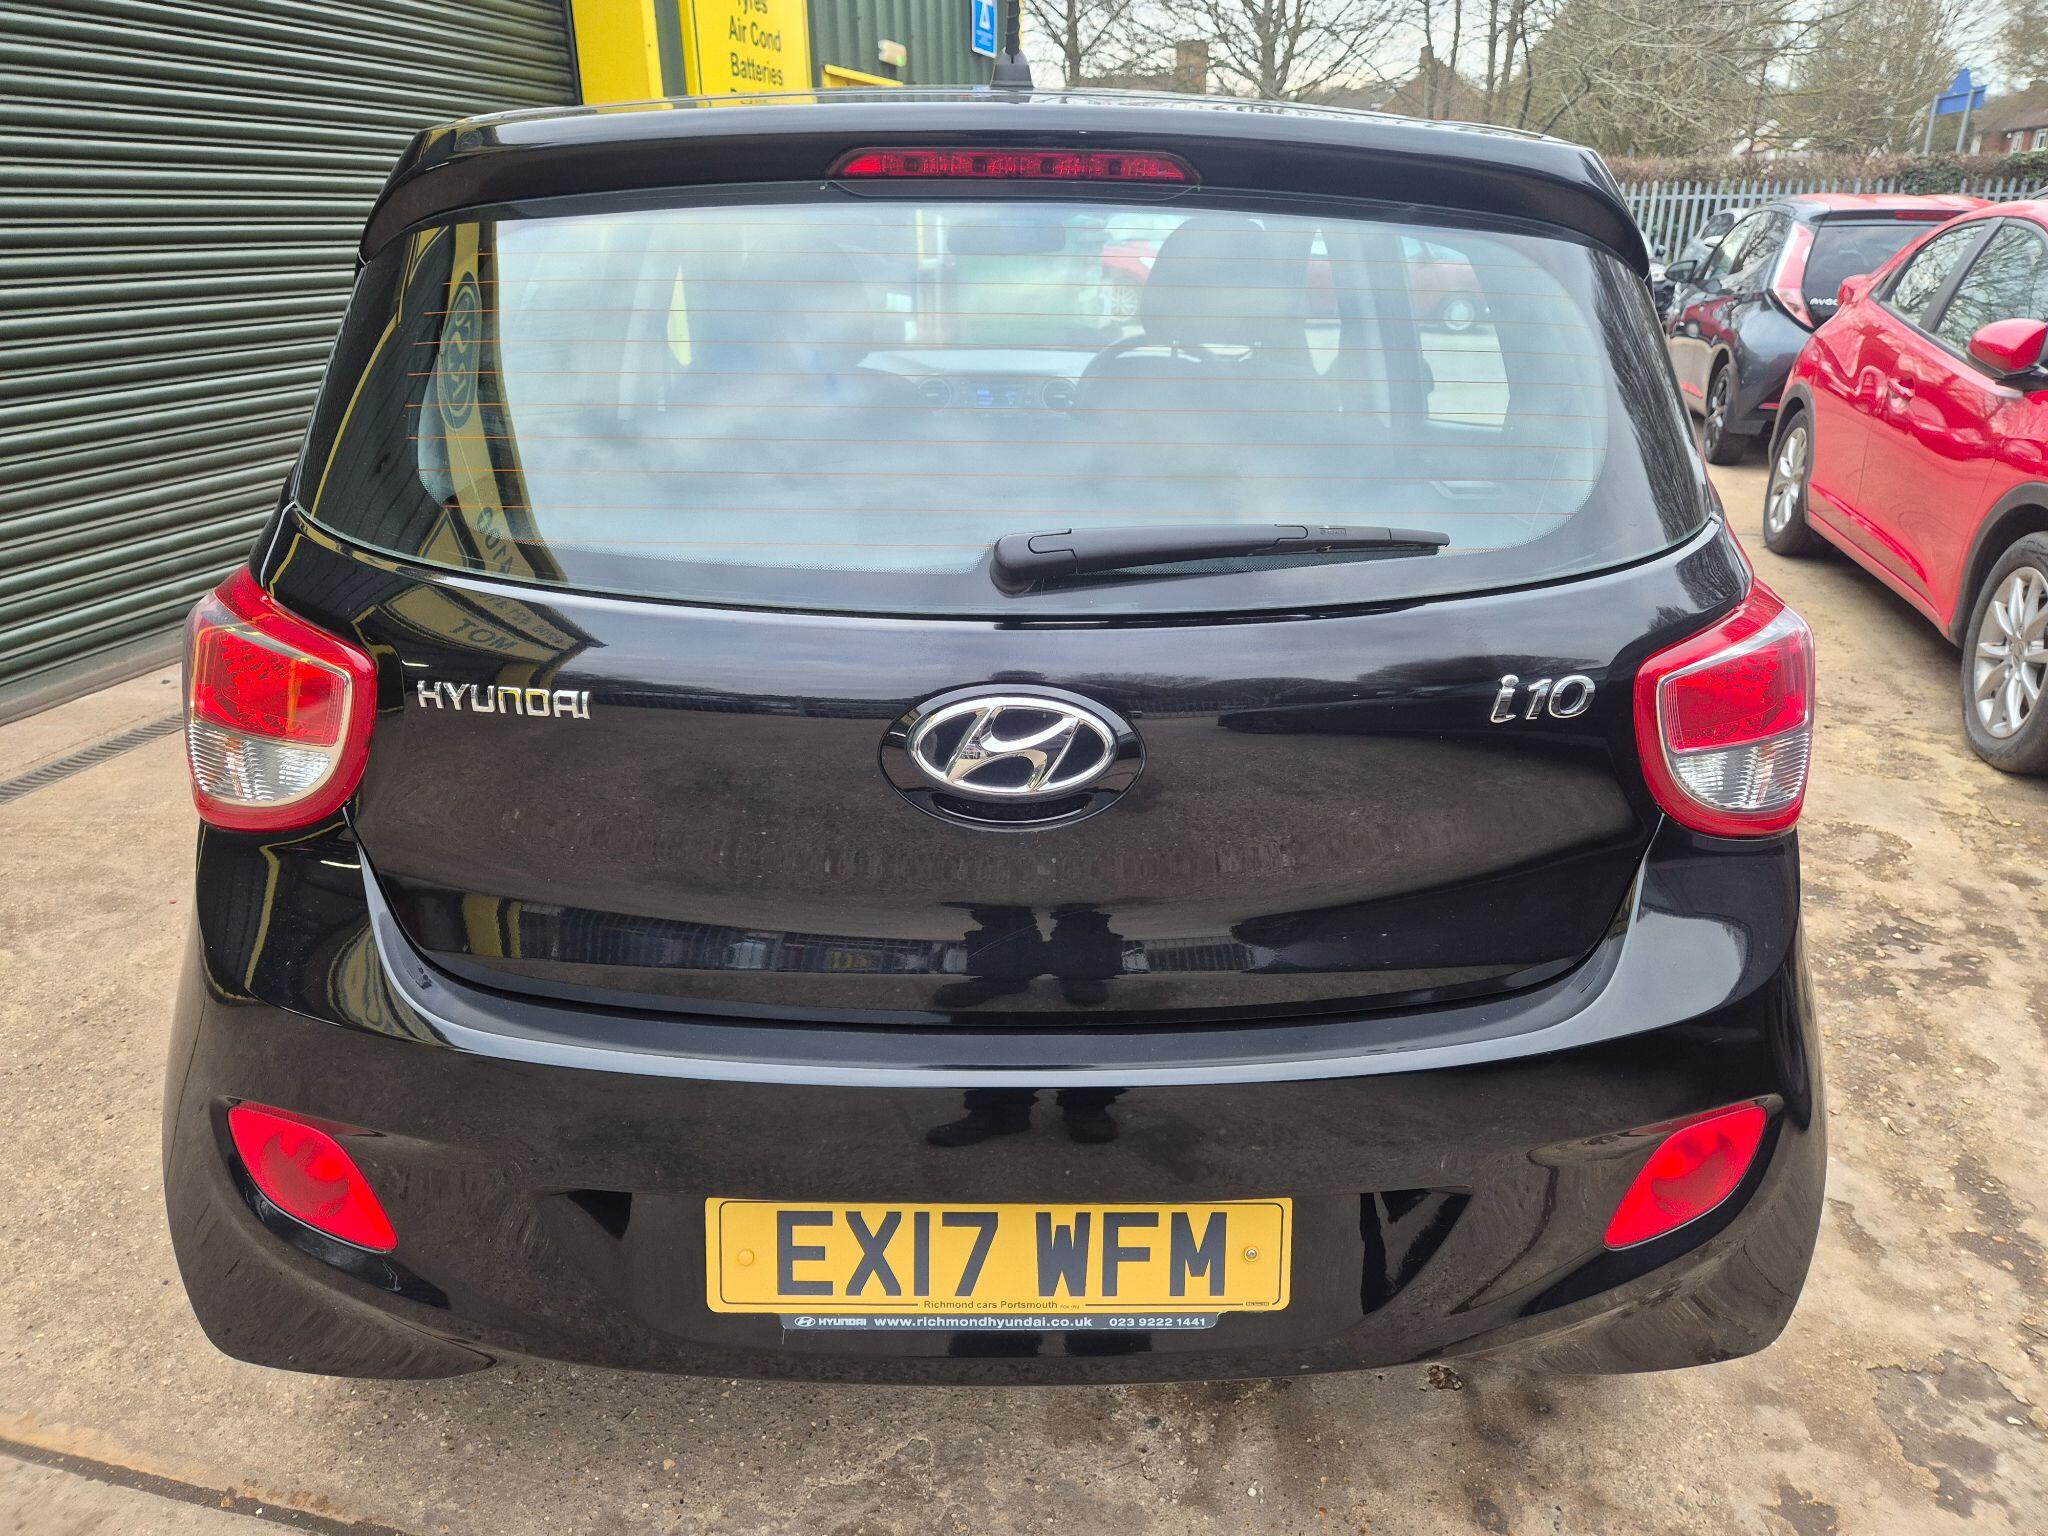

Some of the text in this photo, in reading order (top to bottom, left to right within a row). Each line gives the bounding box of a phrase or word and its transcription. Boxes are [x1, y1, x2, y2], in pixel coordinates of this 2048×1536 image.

[738, 0, 768, 14] yres
[729, 15, 782, 52] Air Cond
[730, 51, 784, 86] Batteries
[417, 680, 590, 719] HYUNDAI
[1490, 674, 1596, 724] i10
[777, 1211, 1228, 1298] EX17 WFM
[818, 1316, 1206, 1329] HYUNDAI www.richmondhyundai.co.uk 023 9222 1441
[923, 1300, 974, 1309] Richmond
[1000, 1300, 1058, 1309] Portsmouth
